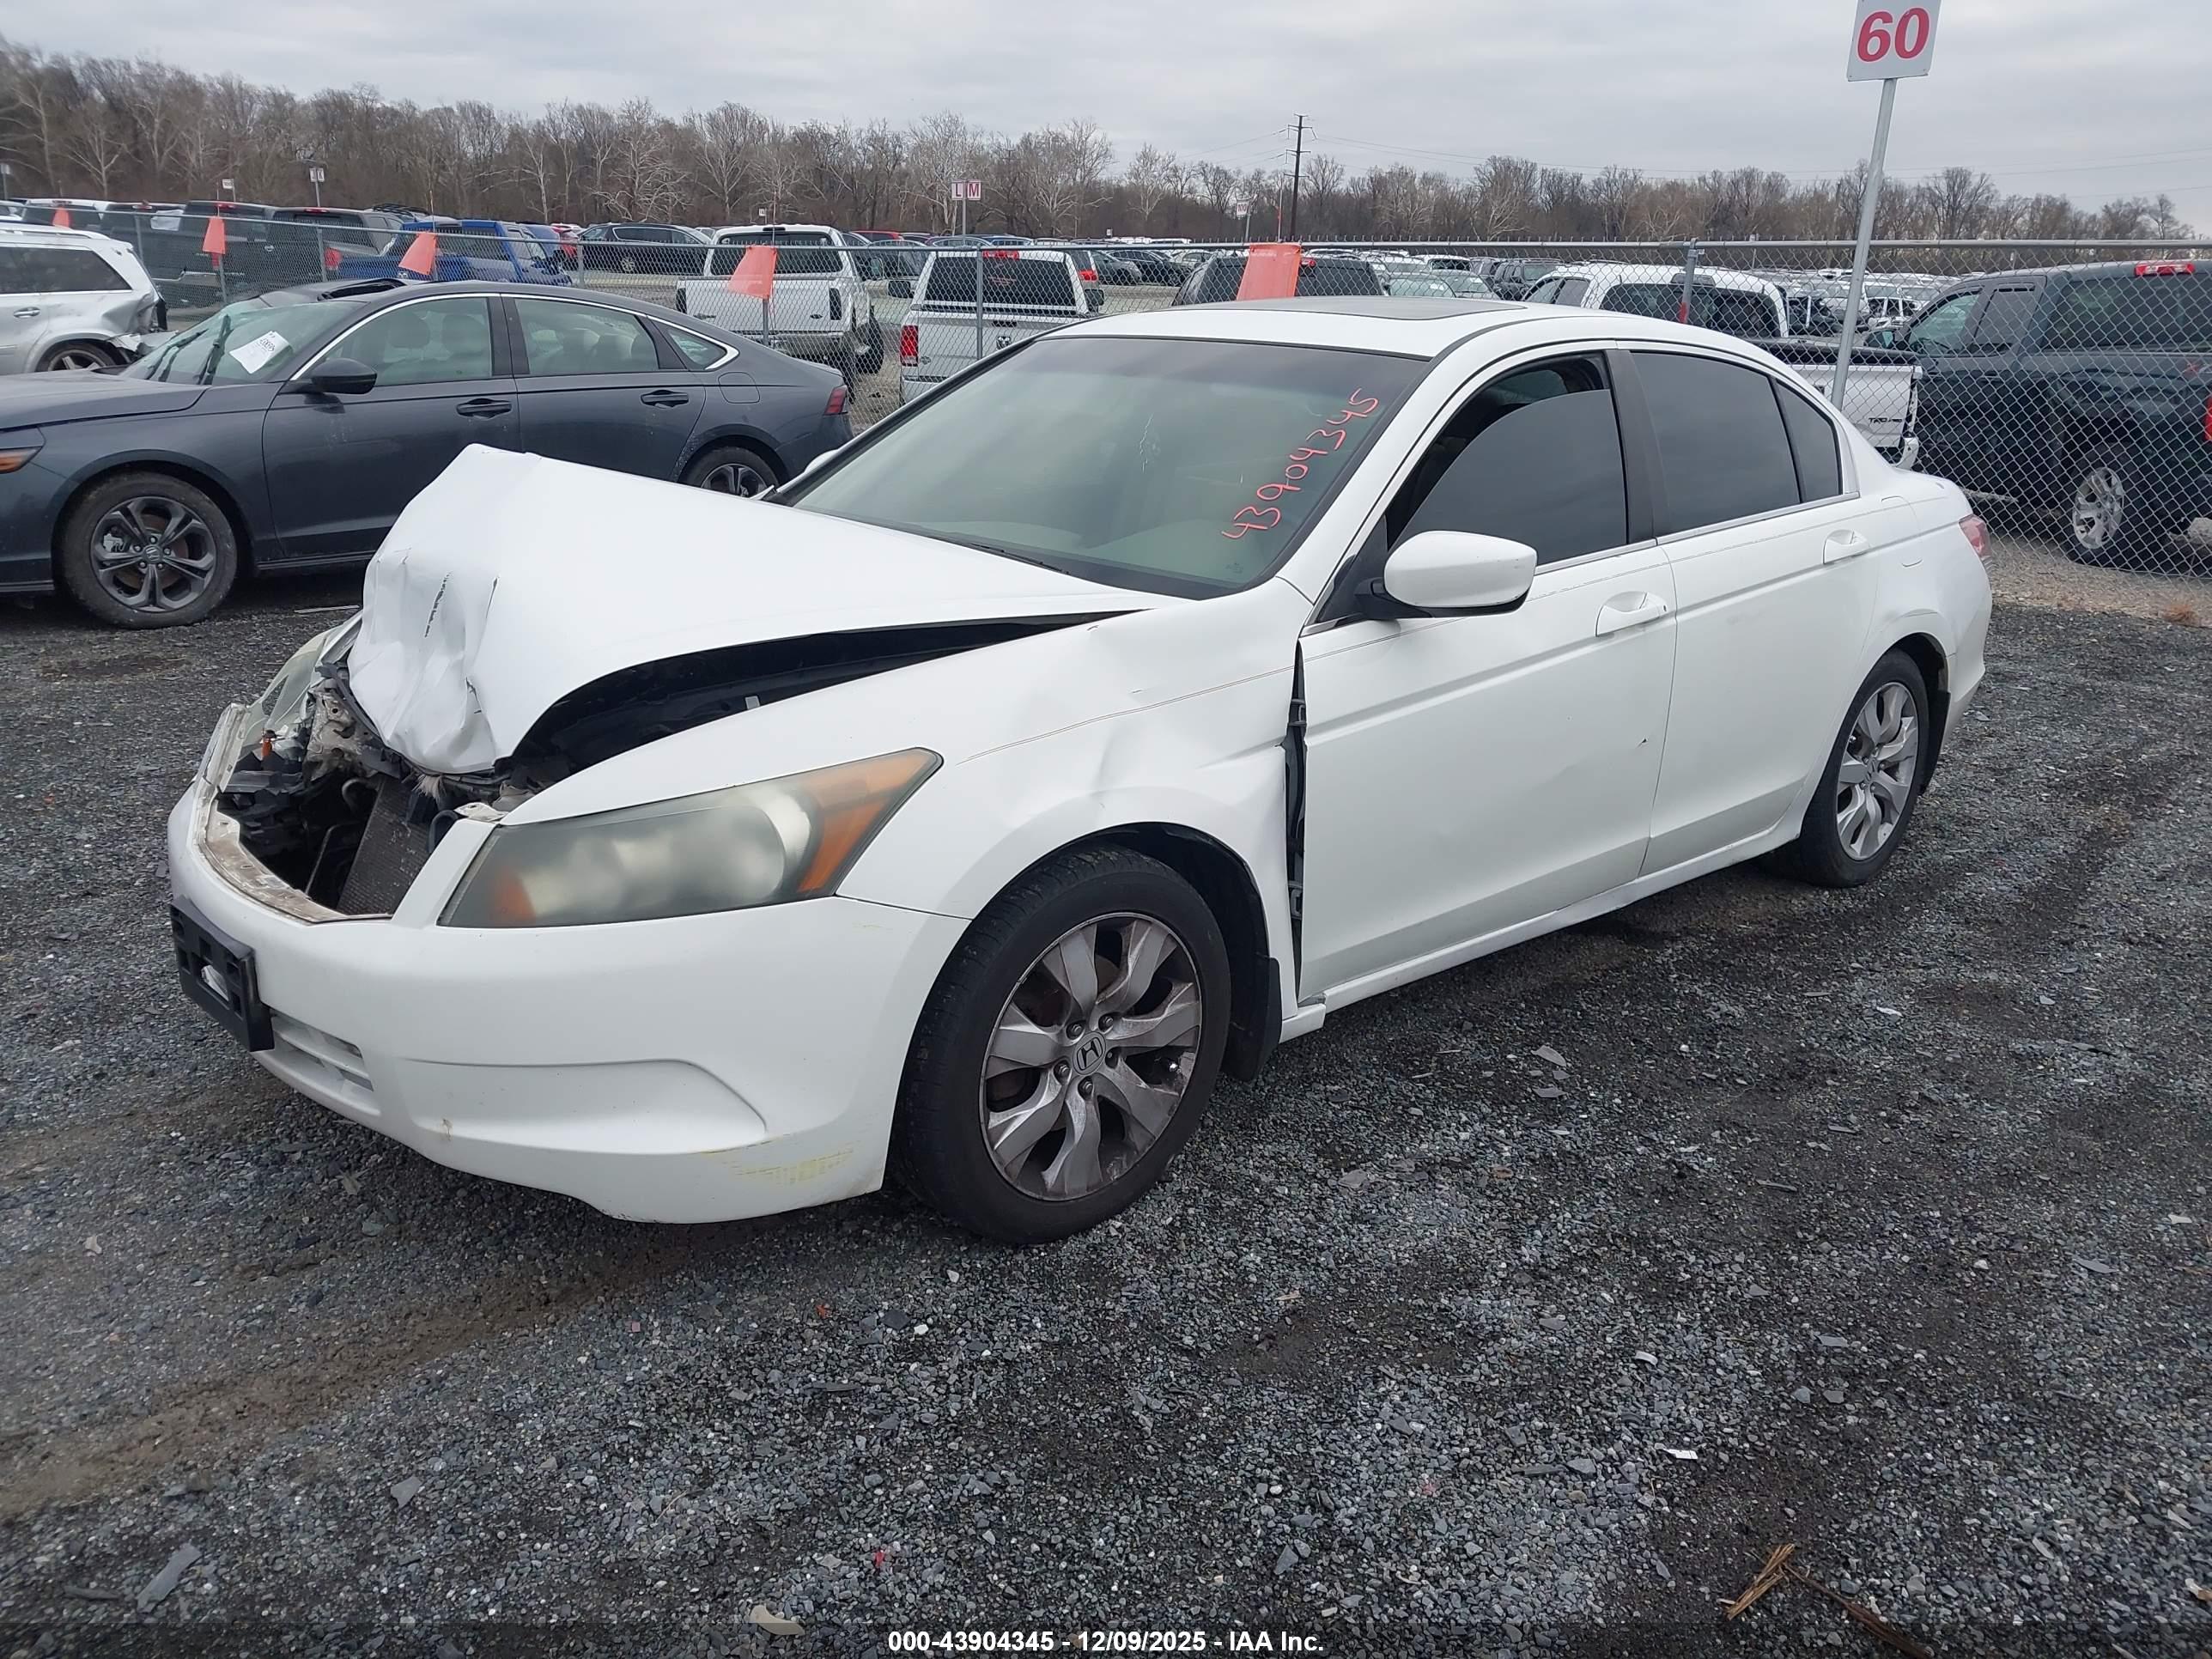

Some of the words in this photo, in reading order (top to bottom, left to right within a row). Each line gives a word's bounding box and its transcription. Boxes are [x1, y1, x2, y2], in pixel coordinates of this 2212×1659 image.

[1856, 7, 1930, 63] 60
[955, 183, 962, 198] L
[969, 183, 979, 198] M
[1220, 387, 1379, 539] 43904345
